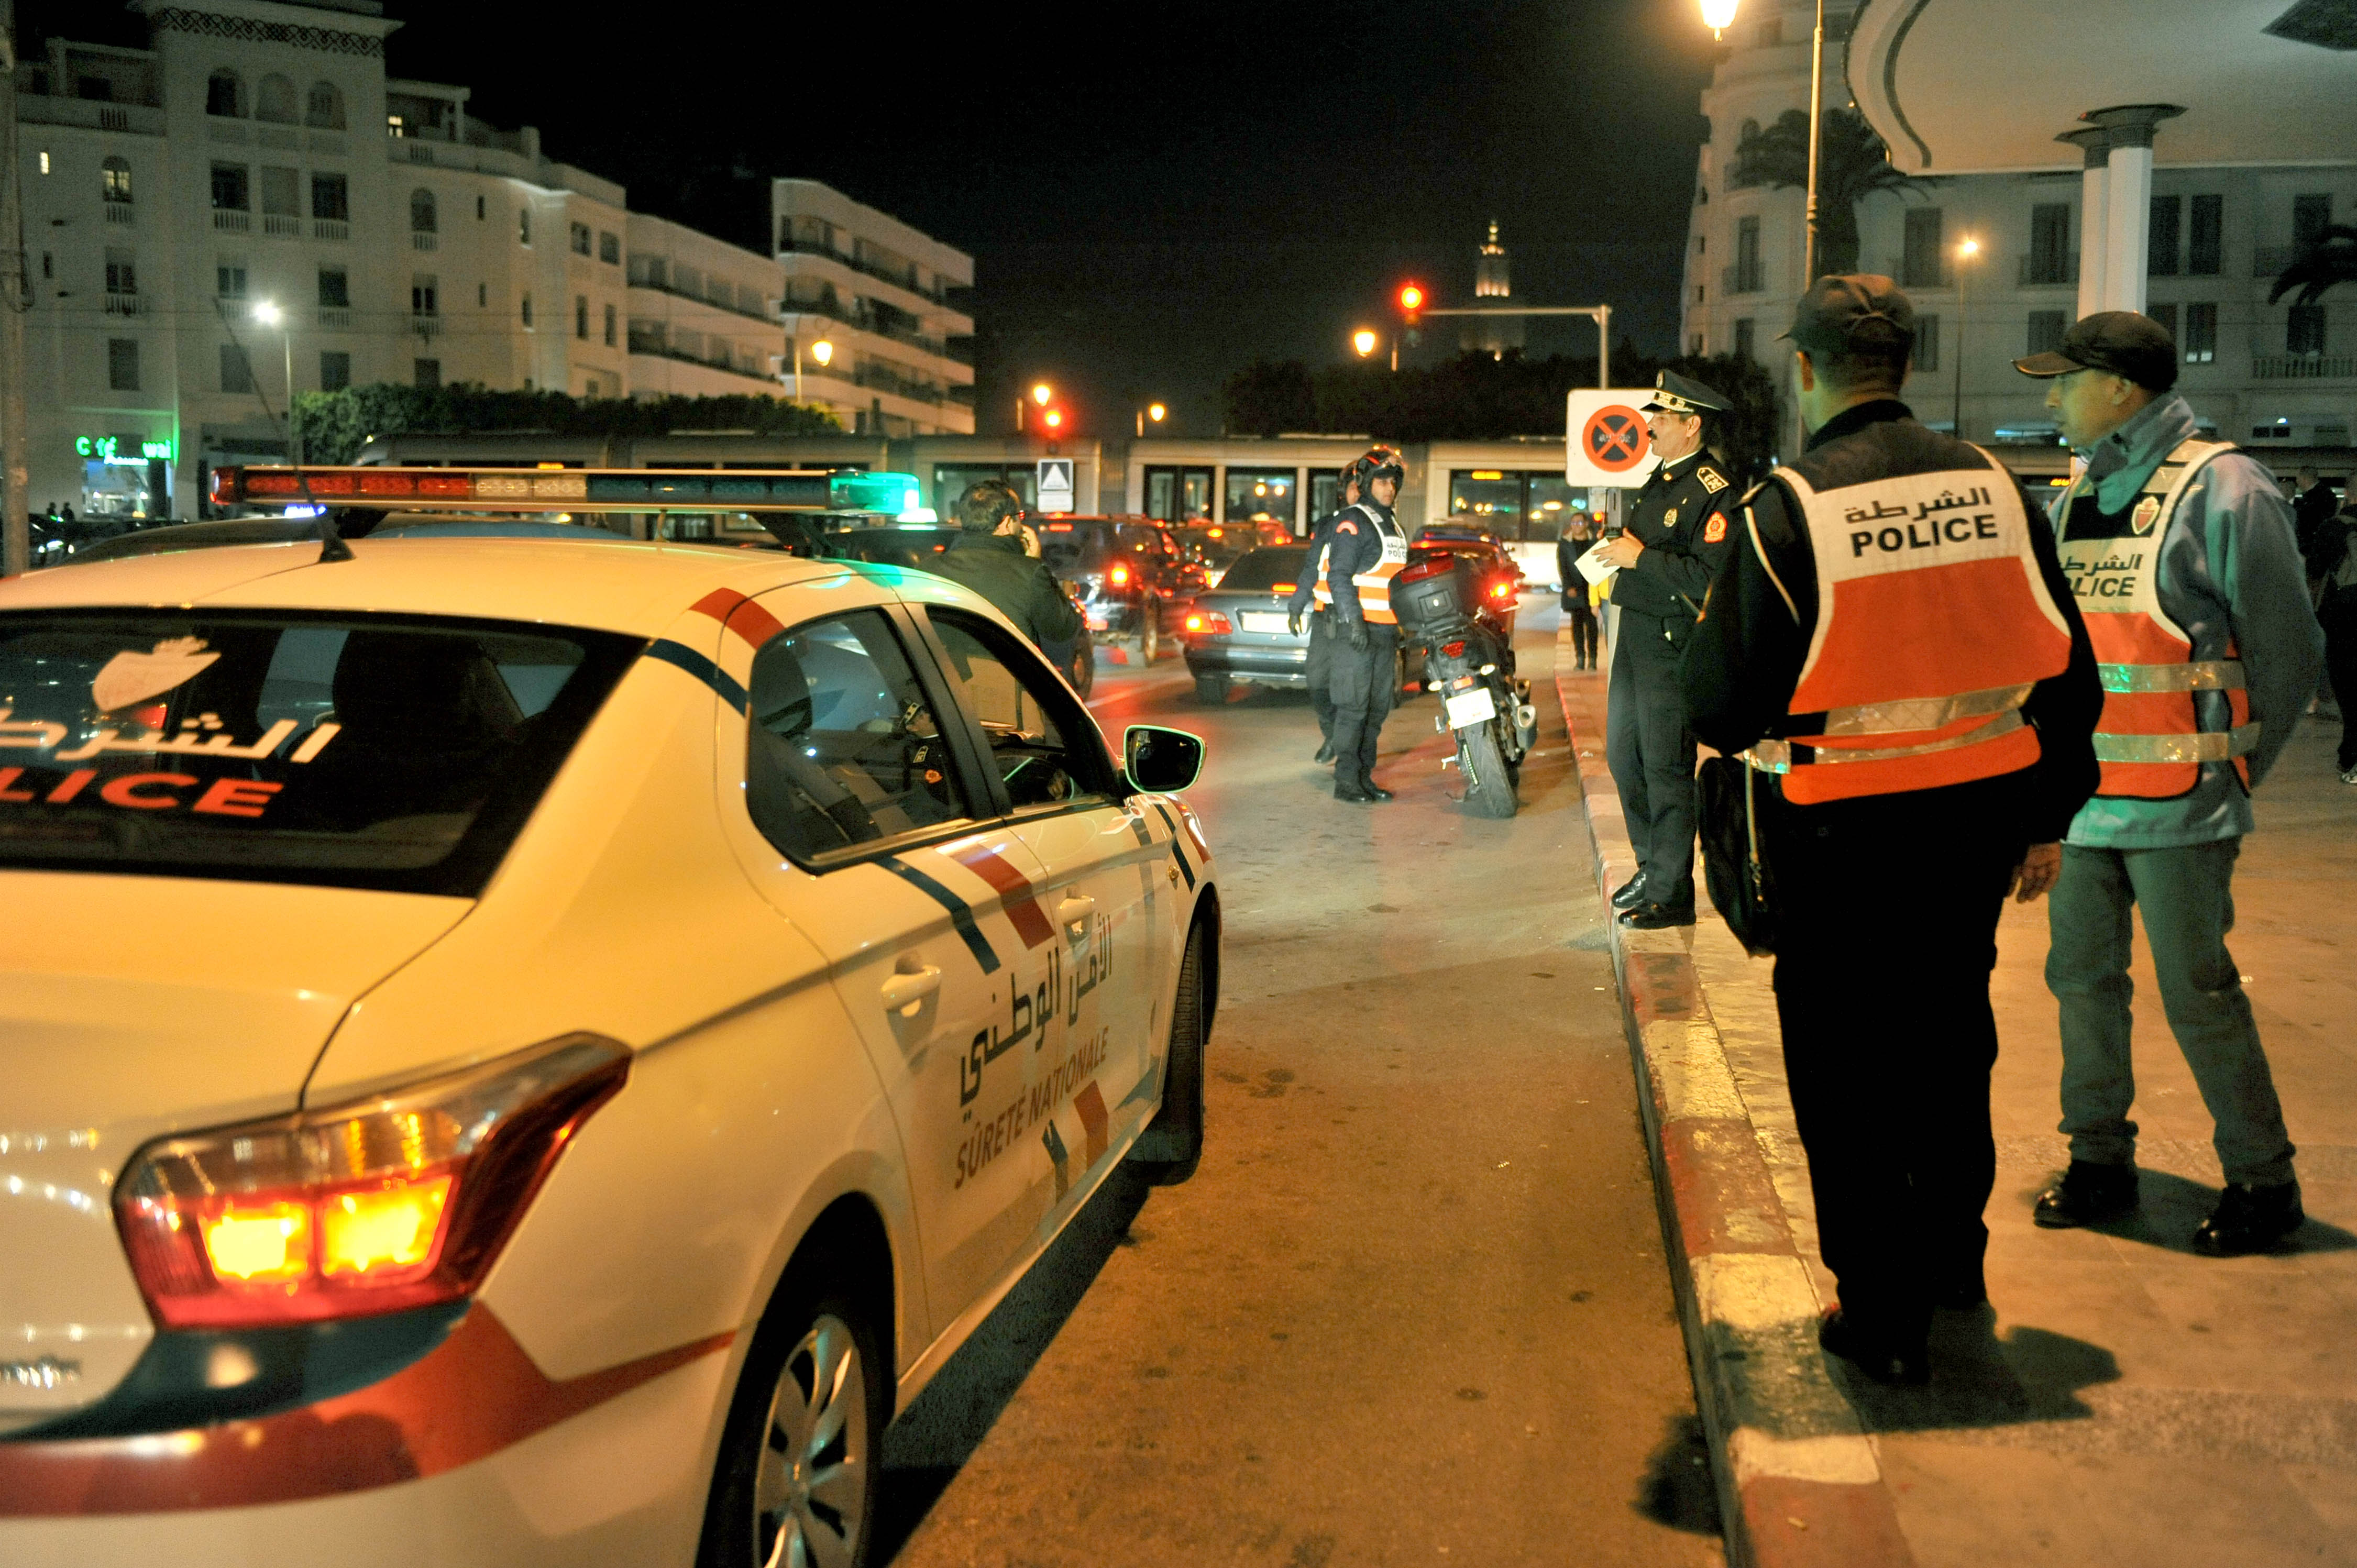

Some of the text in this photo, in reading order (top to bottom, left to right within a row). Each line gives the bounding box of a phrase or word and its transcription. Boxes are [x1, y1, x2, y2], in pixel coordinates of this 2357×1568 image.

[1844, 487, 1991, 523] الشرطة
[1849, 514, 1998, 558] POLICE
[2062, 554, 2143, 576] الشرط
[2066, 576, 2136, 597] LICE
[960, 913, 1112, 1123] الأمن الوطني
[1028, 1025, 1109, 1127] NATIONALE
